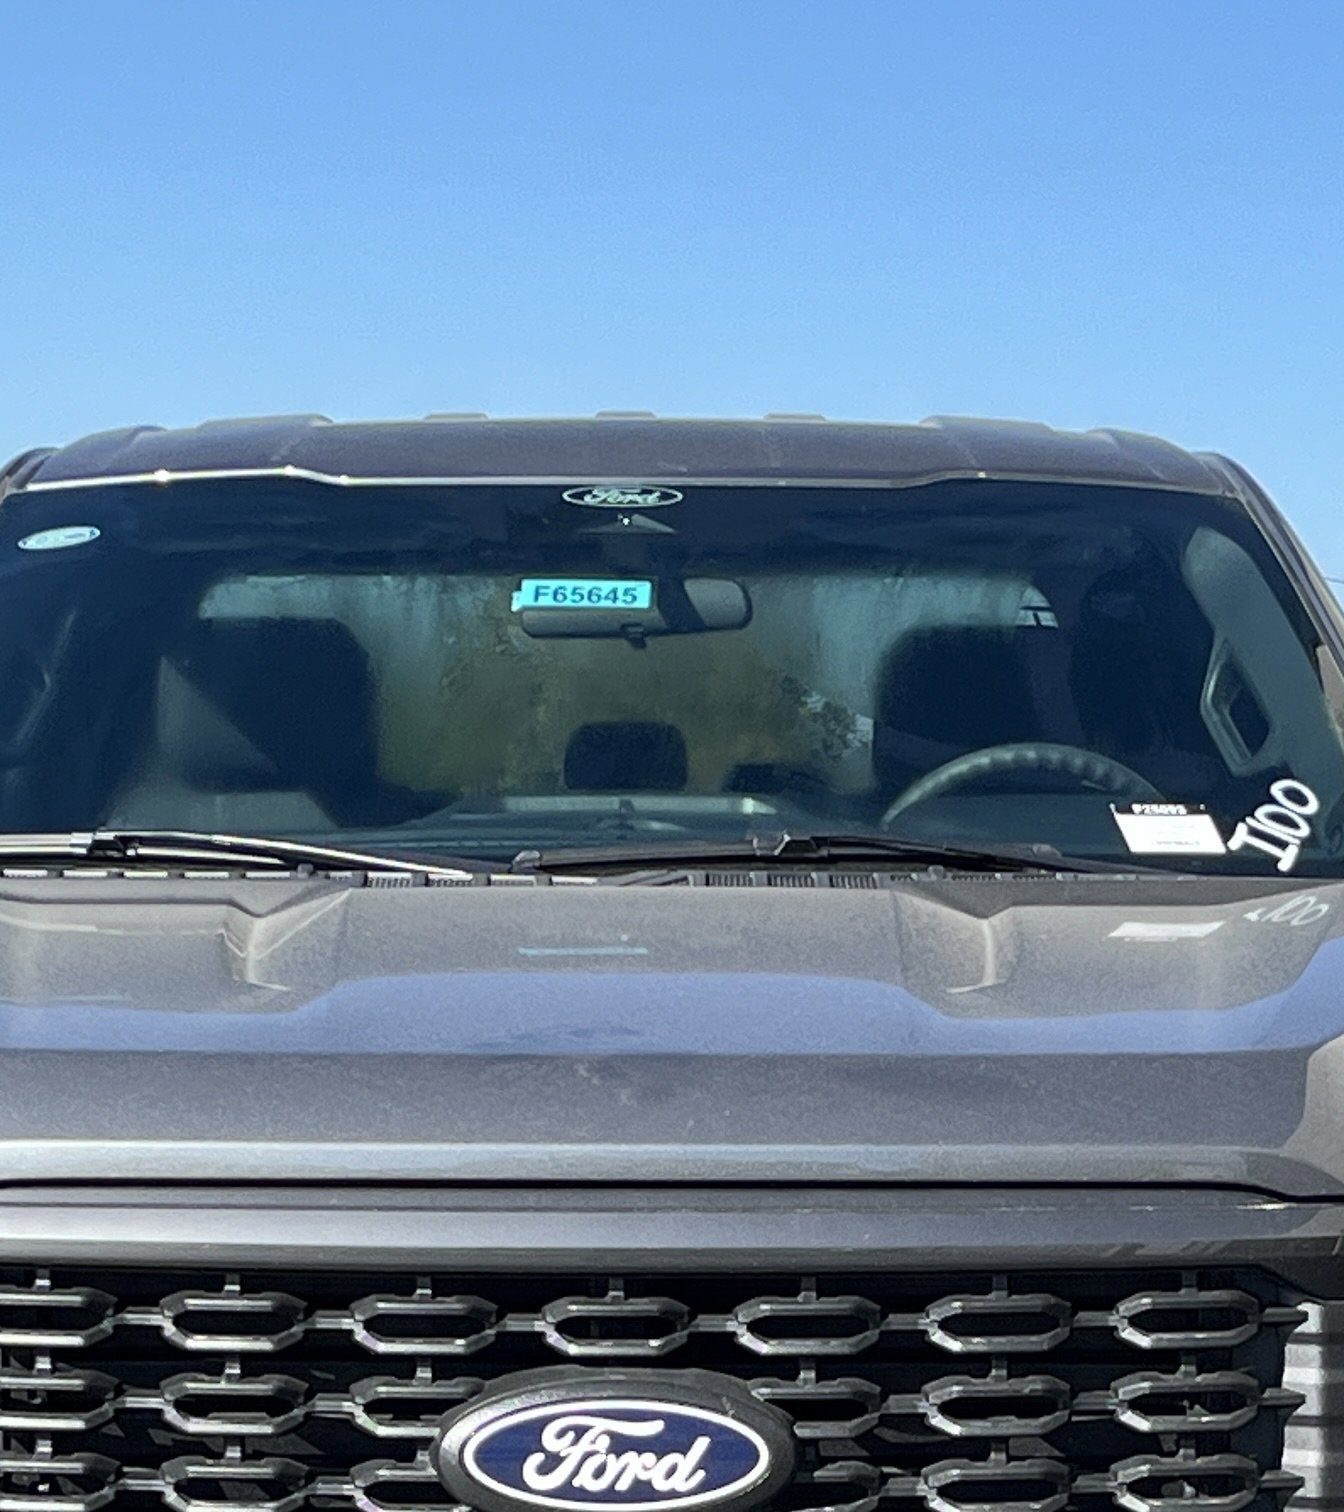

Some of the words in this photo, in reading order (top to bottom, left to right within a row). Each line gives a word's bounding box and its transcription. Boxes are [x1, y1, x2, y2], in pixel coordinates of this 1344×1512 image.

[583, 487, 661, 505] Ford
[534, 585, 638, 604] F65645
[521, 1414, 712, 1494] Ford
